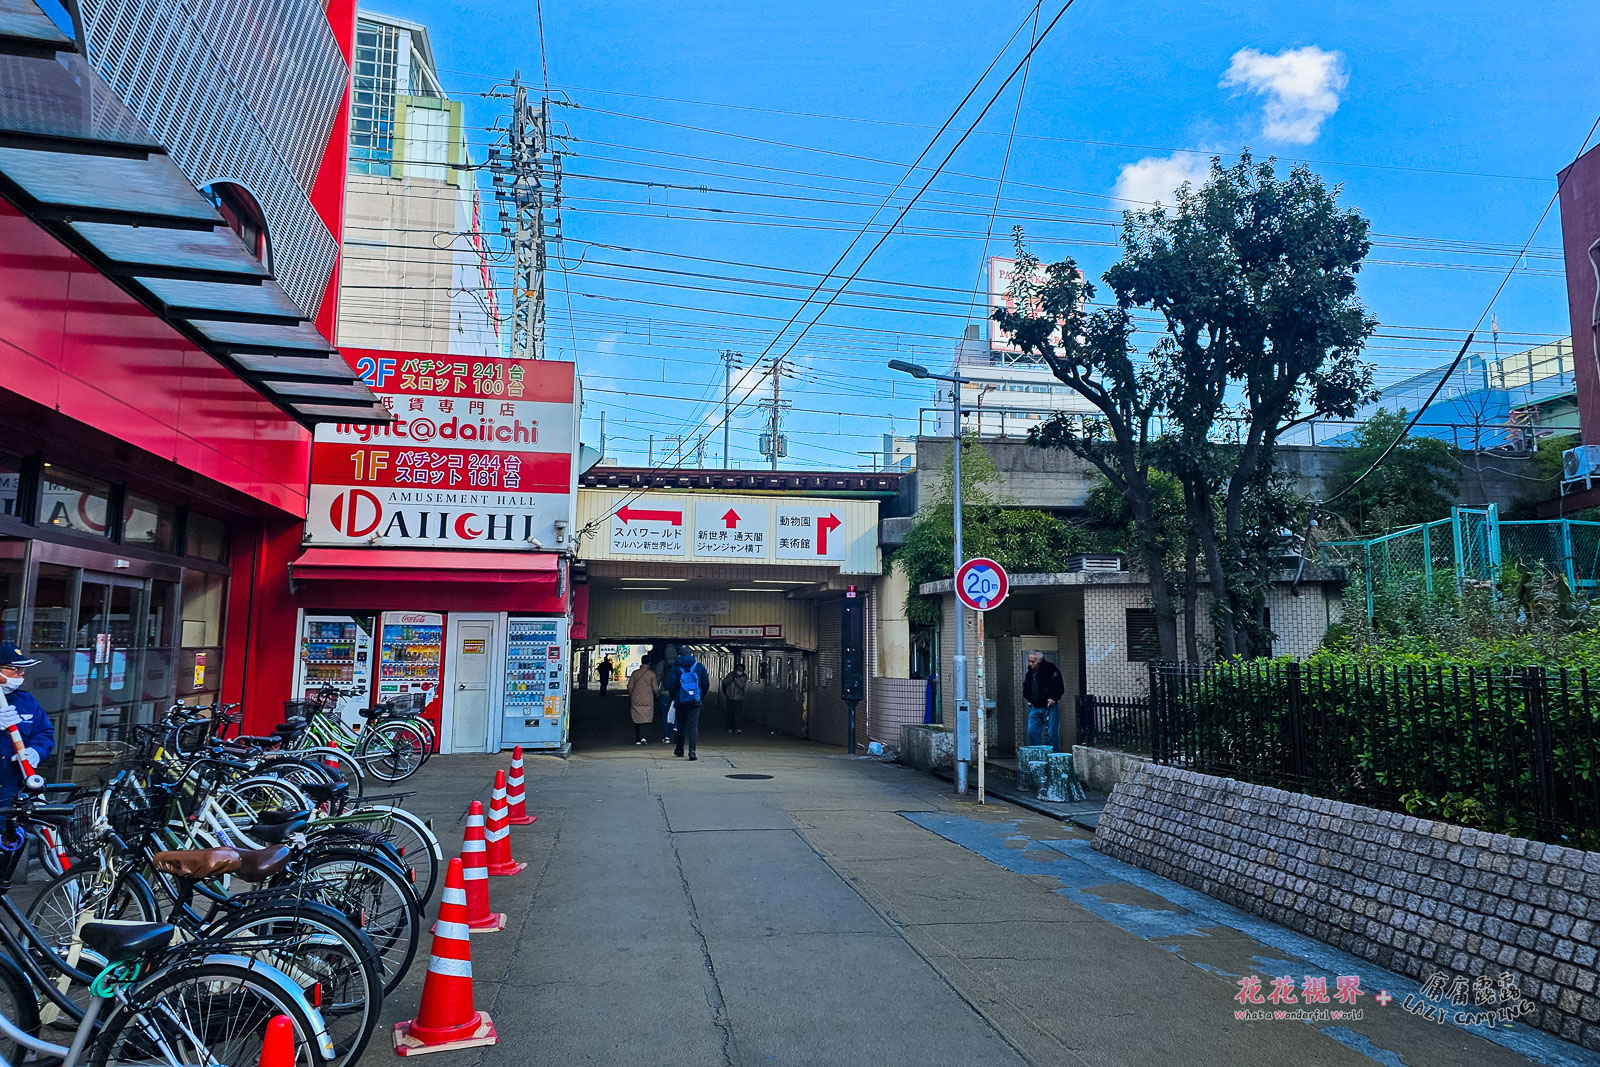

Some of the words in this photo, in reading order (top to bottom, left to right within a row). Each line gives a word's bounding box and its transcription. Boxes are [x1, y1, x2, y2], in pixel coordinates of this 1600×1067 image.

[357, 357, 397, 387] 2F
[401, 359, 468, 376] パチンコ
[473, 363, 502, 379] 241
[508, 364, 525, 382] 台
[400, 374, 466, 393] スロット
[473, 379, 504, 395] 100
[508, 380, 525, 397] 台
[350, 450, 390, 480] 1F
[395, 452, 463, 468] パチンコ
[468, 454, 500, 470] 244
[504, 455, 521, 472] 台
[395, 466, 462, 485] スロット
[468, 471, 498, 486] 181
[504, 471, 521, 488] 台
[389, 491, 489, 505] AMUSEMENT
[497, 495, 536, 506] HALL
[329, 488, 535, 541] DAIICHI
[780, 515, 811, 527] 動物園
[614, 527, 682, 539] スパワールド
[779, 537, 811, 549] 美術館
[614, 540, 681, 550] マルハン新世界ビル
[697, 542, 763, 553] ジャンジャン横丁
